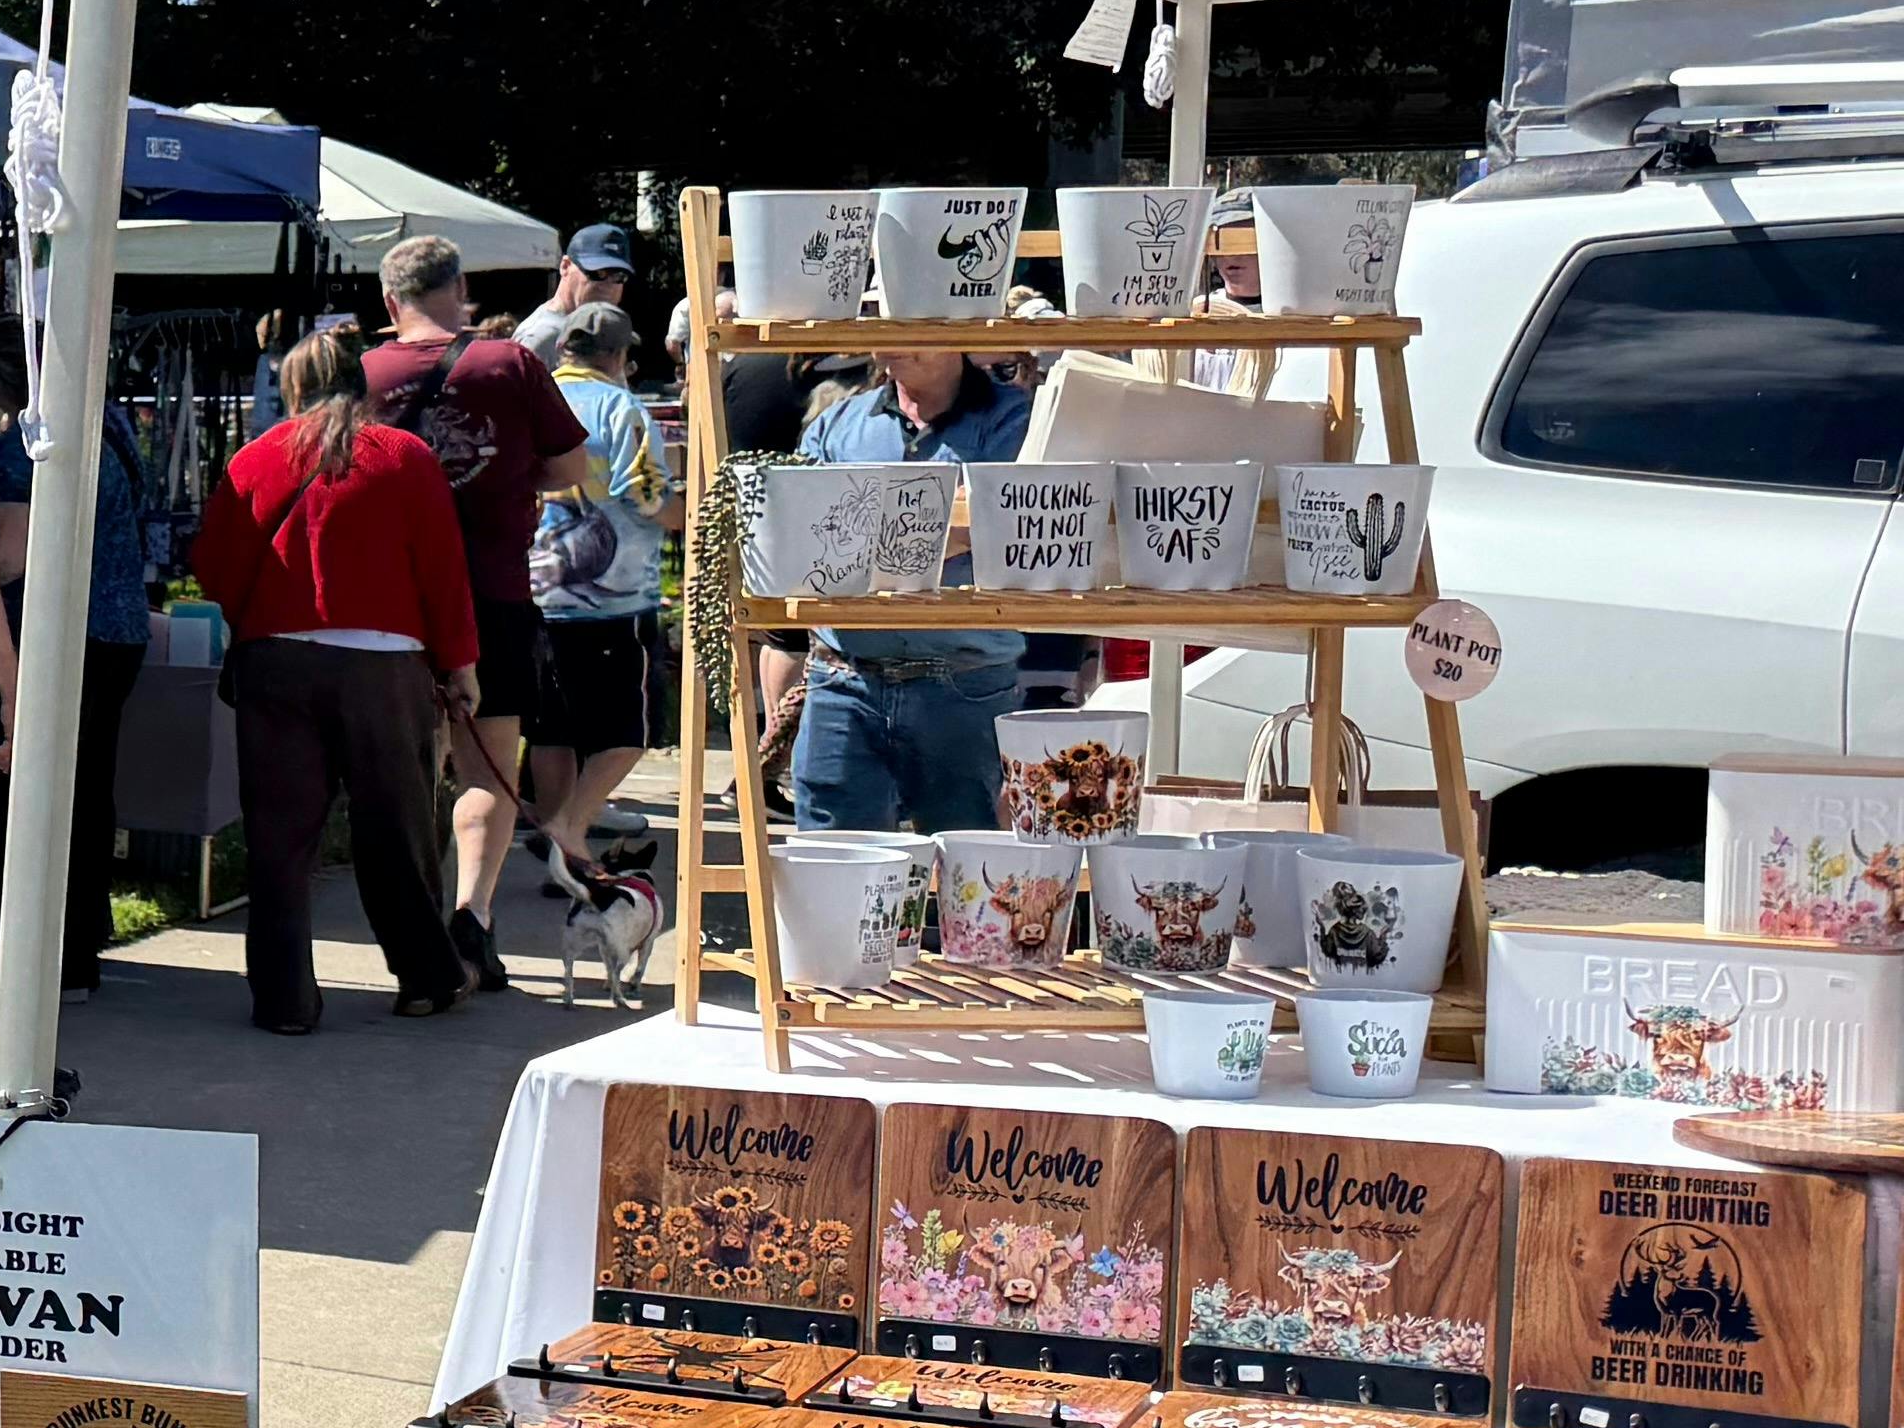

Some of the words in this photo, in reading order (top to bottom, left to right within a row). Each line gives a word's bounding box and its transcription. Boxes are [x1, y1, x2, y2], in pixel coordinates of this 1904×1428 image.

[944, 199, 980, 215] JUST
[986, 200, 1004, 215] DO
[949, 282, 997, 298] LATER.
[1133, 485, 1234, 525] THIRSTY
[1300, 499, 1346, 512] CACTUS
[1017, 514, 1042, 540] I'M
[1051, 512, 1088, 539] NOT
[1005, 543, 1062, 570] DEAD
[1068, 540, 1095, 568] YET
[1164, 528, 1204, 564] AF
[1410, 622, 1464, 653] PLANT
[1466, 639, 1502, 666] POT
[1433, 658, 1463, 682] $20
[1582, 954, 1789, 1008] BREAD
[1347, 1019, 1407, 1058] Succa
[668, 1104, 814, 1166] Welcome
[947, 1125, 1104, 1191] Welcome
[1256, 1152, 1428, 1221] Welcome
[1612, 1172, 1680, 1193] WEEKEND
[1684, 1177, 1758, 1198] FORECAST
[1598, 1189, 1658, 1220] DEER
[1666, 1195, 1770, 1228] HUNTING
[1610, 1338, 1647, 1358] WITH
[1651, 1342, 1661, 1359] A
[1665, 1343, 1724, 1364] CHANCE
[1728, 1348, 1748, 1367] OF
[916, 1362, 1079, 1393] Welcome
[1592, 1355, 1647, 1385] BEER
[1655, 1361, 1765, 1396] DRINKING
